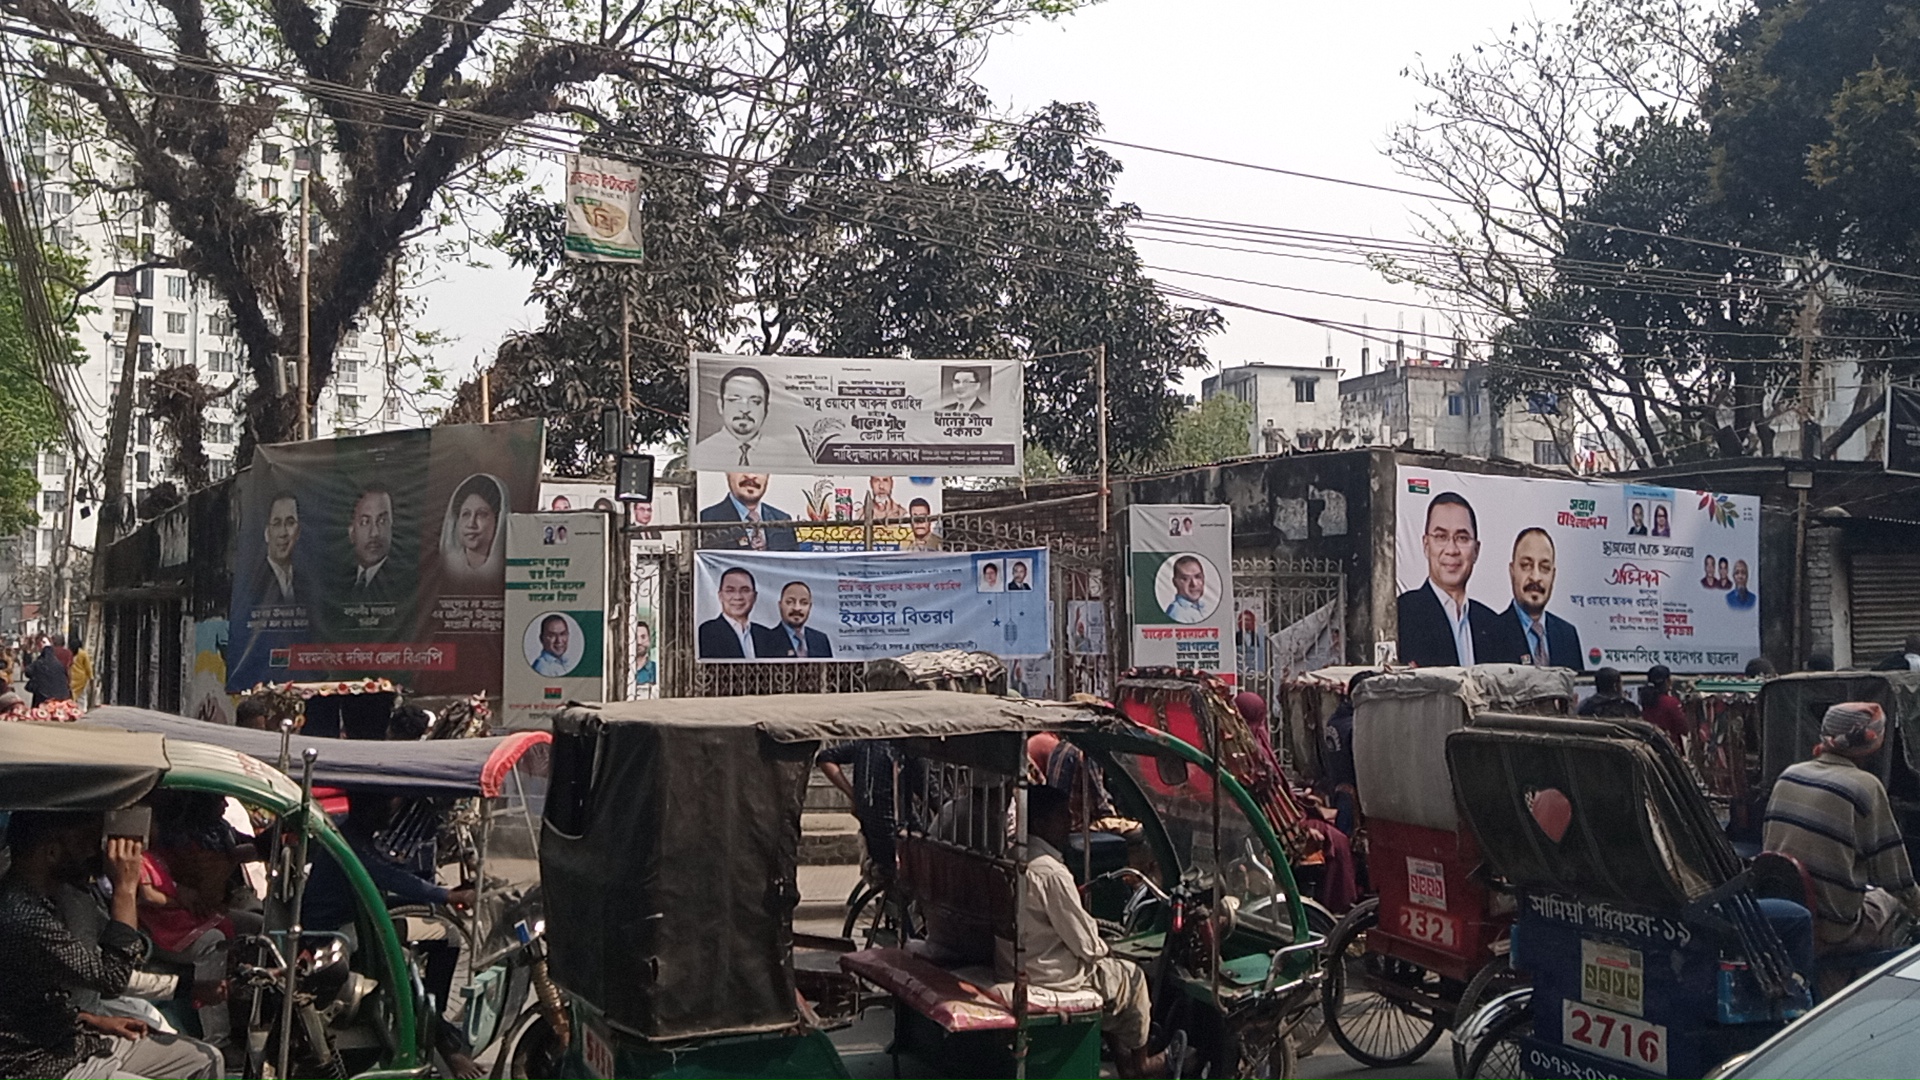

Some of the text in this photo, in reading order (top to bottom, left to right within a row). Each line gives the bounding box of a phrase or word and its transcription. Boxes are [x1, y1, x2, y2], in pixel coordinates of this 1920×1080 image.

[803, 398, 822, 412] আবু
[891, 395, 923, 411] ওয়াহিদ
[851, 413, 906, 430] ধানের শীষে
[934, 416, 966, 427] ধানের
[968, 413, 993, 427] শীষে
[860, 431, 905, 441] ভোট দিন
[943, 427, 983, 438] একমত
[1570, 499, 1596, 515] সবার
[1557, 511, 1608, 530] বাংলাদেশ
[1604, 563, 1670, 588] অভিনন্দন
[839, 607, 954, 627] ইফতার বিতরণ
[297, 647, 443, 666] ময়মনসিংহ দক্ষিণ জেলা বিএনপি
[1604, 645, 1740, 666] ময়মনসিংহ মহানগর ছাত্রদল
[1528, 893, 1584, 925] সামিয়া
[1399, 907, 1460, 946] 2321
[1585, 965, 1641, 998] ২৭১৬
[1572, 1009, 1660, 1064] 2716
